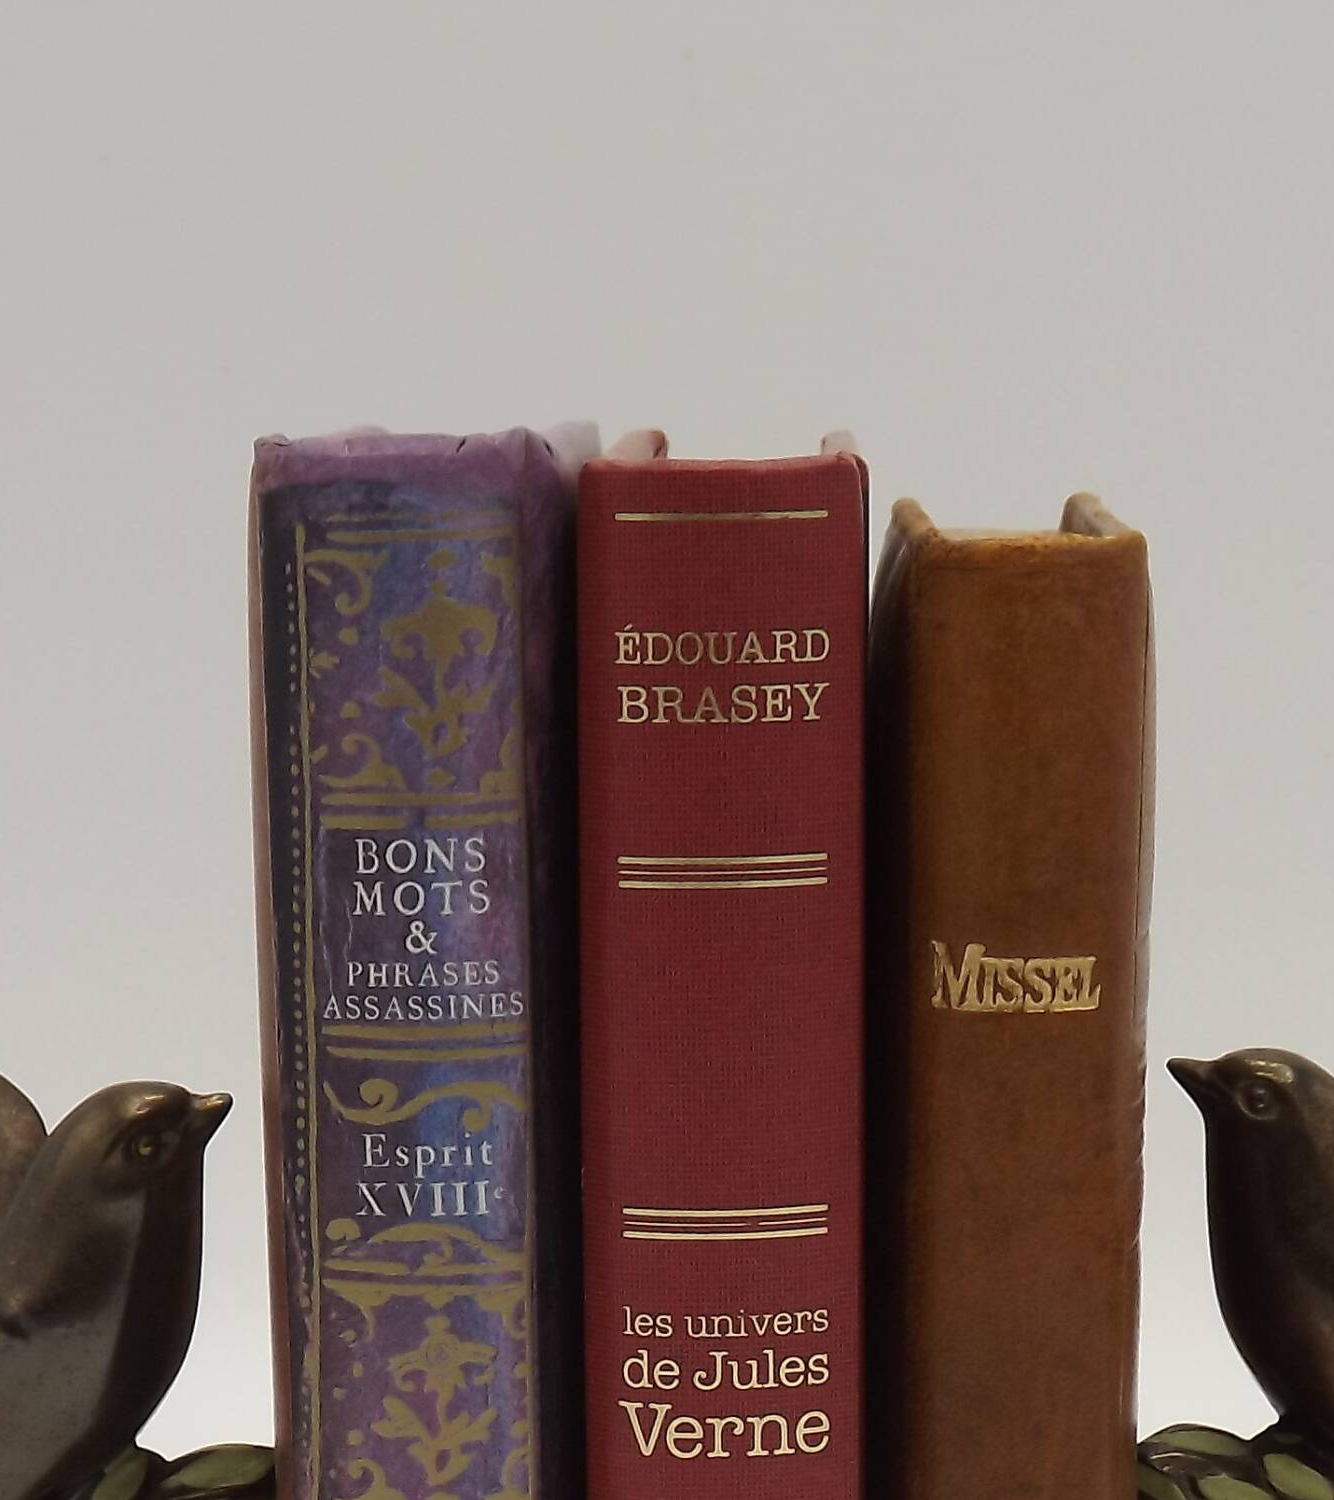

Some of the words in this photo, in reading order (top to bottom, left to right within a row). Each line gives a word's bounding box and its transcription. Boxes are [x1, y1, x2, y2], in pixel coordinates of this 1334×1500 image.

[614, 623, 831, 666] ÉDOUARD
[616, 682, 830, 724] BRASEY
[354, 837, 487, 875] BONS
[352, 879, 492, 917] MOTS
[404, 920, 439, 955] &
[346, 960, 501, 988] PHRASES
[930, 940, 1102, 1014] MISSEL
[322, 991, 524, 1022] ASSASSINES
[362, 1132, 494, 1180] Esprit
[622, 1306, 674, 1338] les
[683, 1308, 830, 1339] univers
[622, 1349, 681, 1391] de
[692, 1349, 831, 1391] Jules
[618, 1400, 831, 1460] Verne
